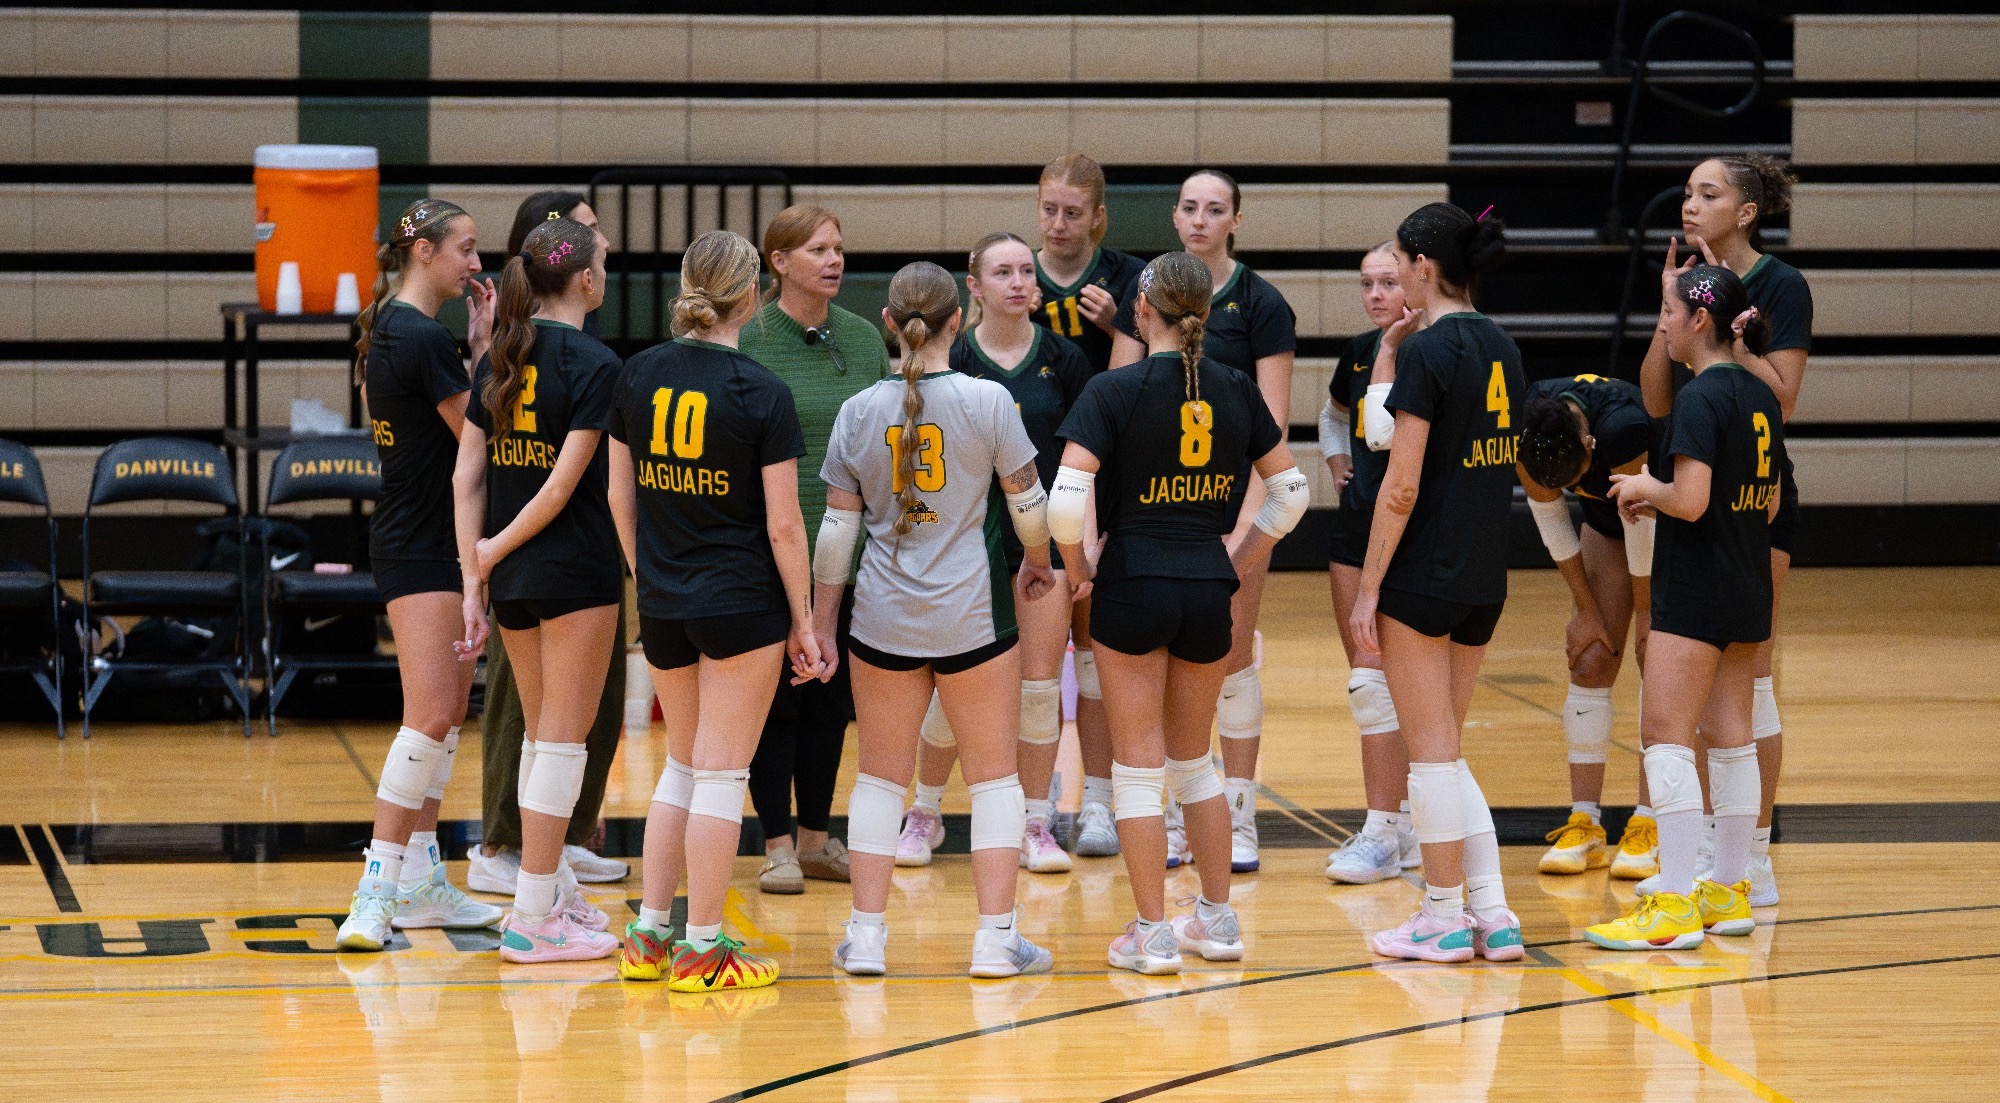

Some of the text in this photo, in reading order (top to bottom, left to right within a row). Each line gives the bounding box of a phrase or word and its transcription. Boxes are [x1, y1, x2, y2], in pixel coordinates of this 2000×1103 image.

[1046, 296, 1083, 336] 11
[513, 365, 538, 433] 2
[1486, 361, 1510, 428] 4
[650, 387, 707, 459] 10
[1180, 400, 1213, 467] 8
[1752, 412, 1771, 478] 2
[115, 460, 216, 478] DANVILLE
[290, 460, 382, 477] DANVILL
[491, 443, 558, 470] AGUARS
[638, 461, 730, 496] JAGUARS
[885, 423, 946, 494] 13
[1139, 474, 1235, 504] JAGUARS
